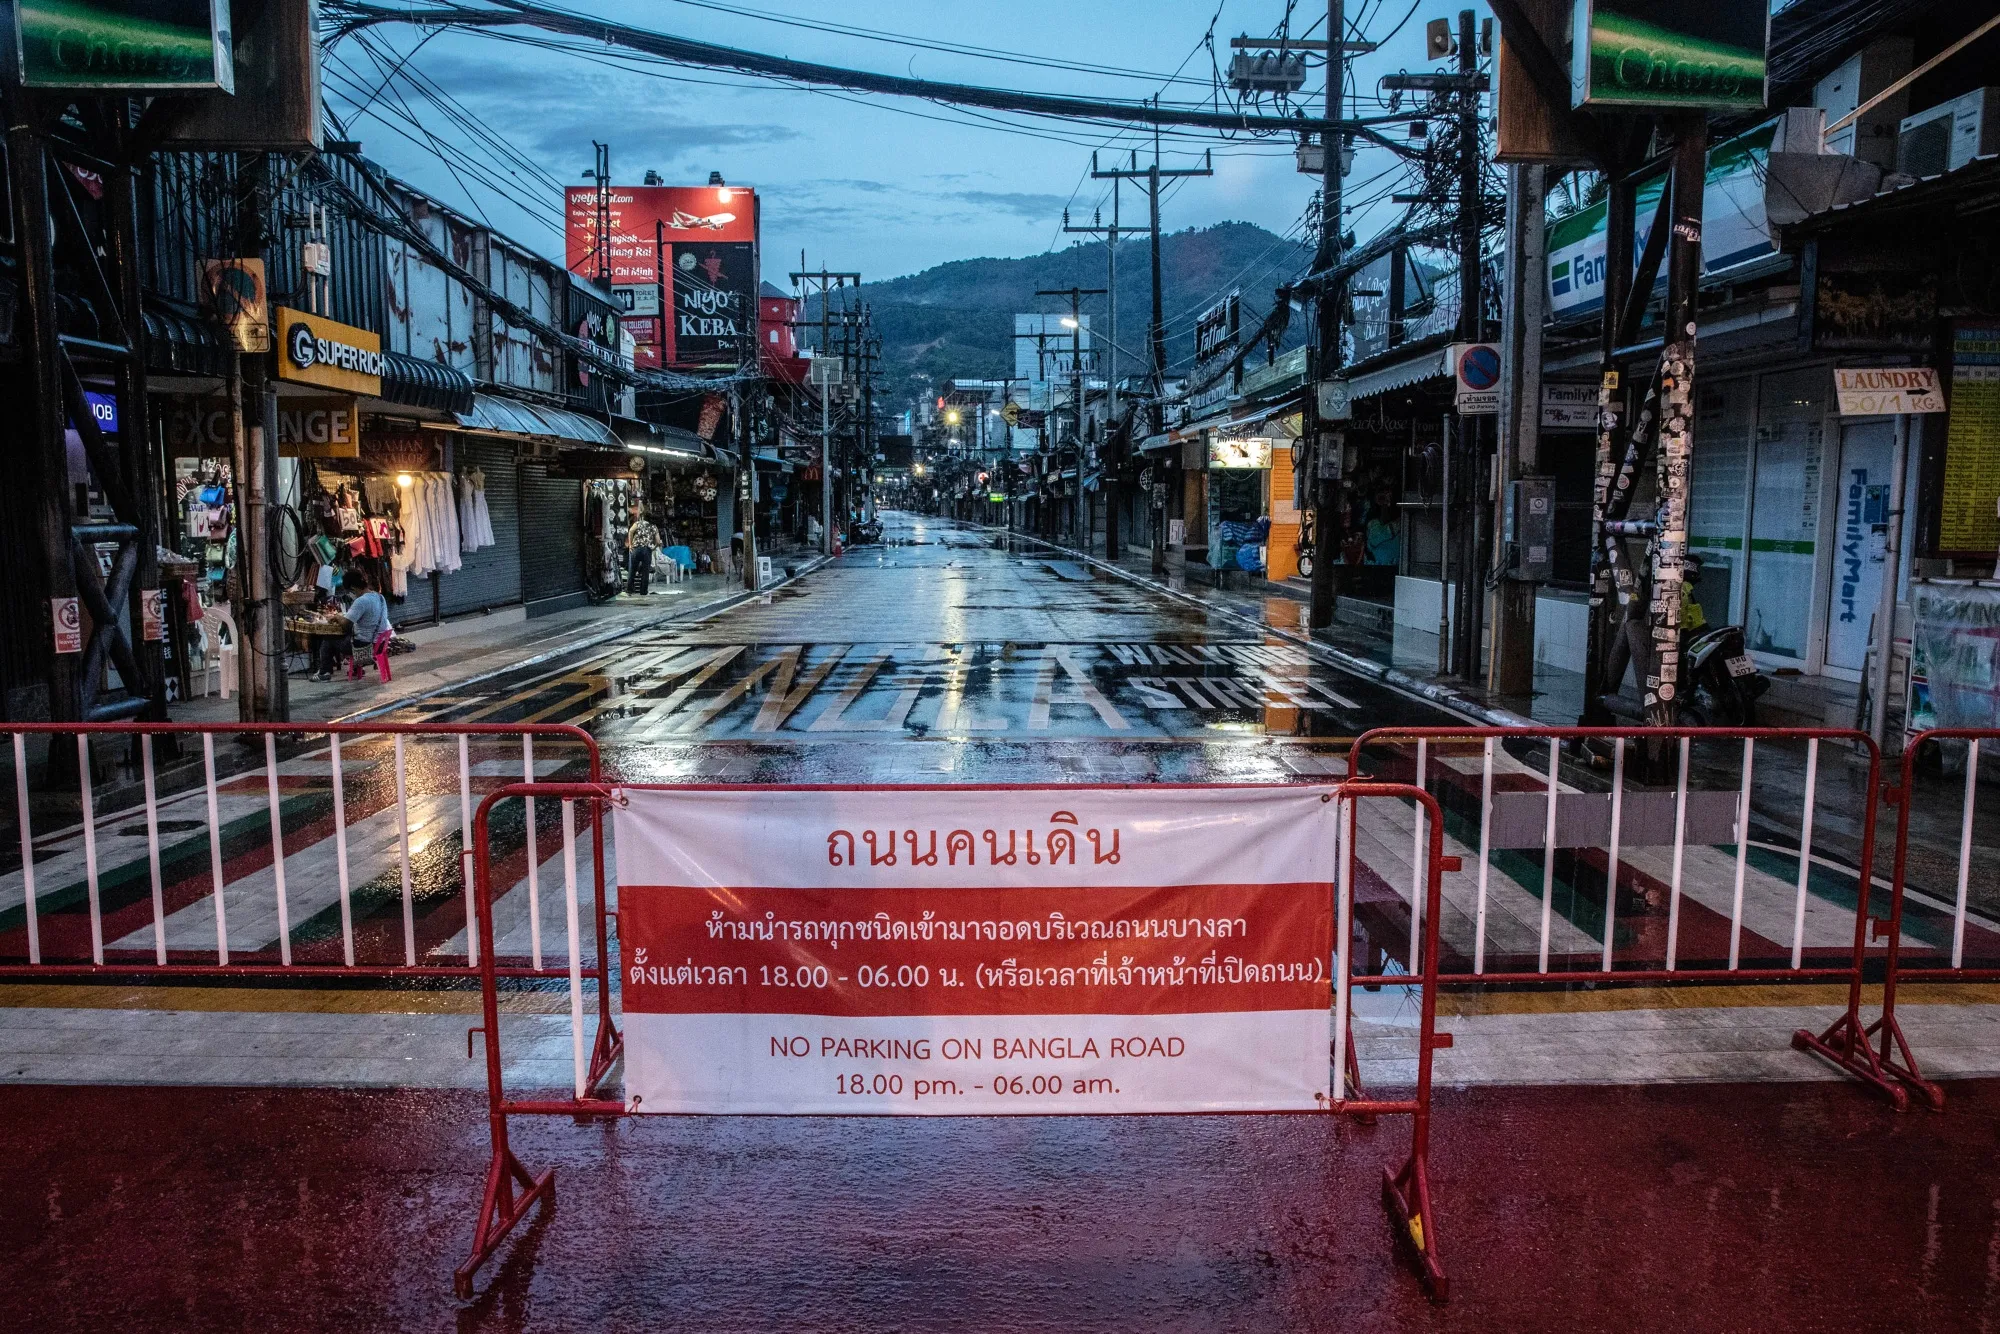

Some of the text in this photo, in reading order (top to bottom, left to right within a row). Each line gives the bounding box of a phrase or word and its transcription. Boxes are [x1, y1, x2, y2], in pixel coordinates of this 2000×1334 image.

[600, 234, 638, 245] Bngkok
[635, 246, 652, 257] Rai
[614, 266, 629, 276] Chi
[631, 266, 653, 276] Minh
[679, 315, 738, 336] KEBA
[1841, 371, 1935, 389] LAUNDRY
[1548, 387, 1598, 402] FamilyM
[1842, 392, 1902, 413] 50/1
[169, 409, 350, 445] EXCNGE
[1839, 468, 1868, 624] FamilyMart
[1105, 643, 1323, 666] WALKING
[1735, 667, 1751, 676] 507
[1127, 676, 1362, 709] STREET
[828, 810, 1122, 867] ถนนคนเดิน
[705, 910, 1248, 951] ห้ามนำรถทุกชนิดเข้ามาจอดบริเวณถนนบางลา
[630, 948, 747, 985] ตั้งแต่เวลา
[760, 965, 828, 988] 18.00
[857, 965, 929, 988] 06.00
[938, 968, 965, 987] น.
[974, 950, 1324, 988] (หรือเวลาที่เจ้าหน้าที่เปิดถนน)
[771, 1035, 1186, 1061] NO PARKING ON BANGLA ROAD
[837, 1074, 903, 1095] 18.00
[913, 1079, 964, 1099] pm.
[992, 1074, 1063, 1096] 06.00
[1072, 1078, 1121, 1096] am.
